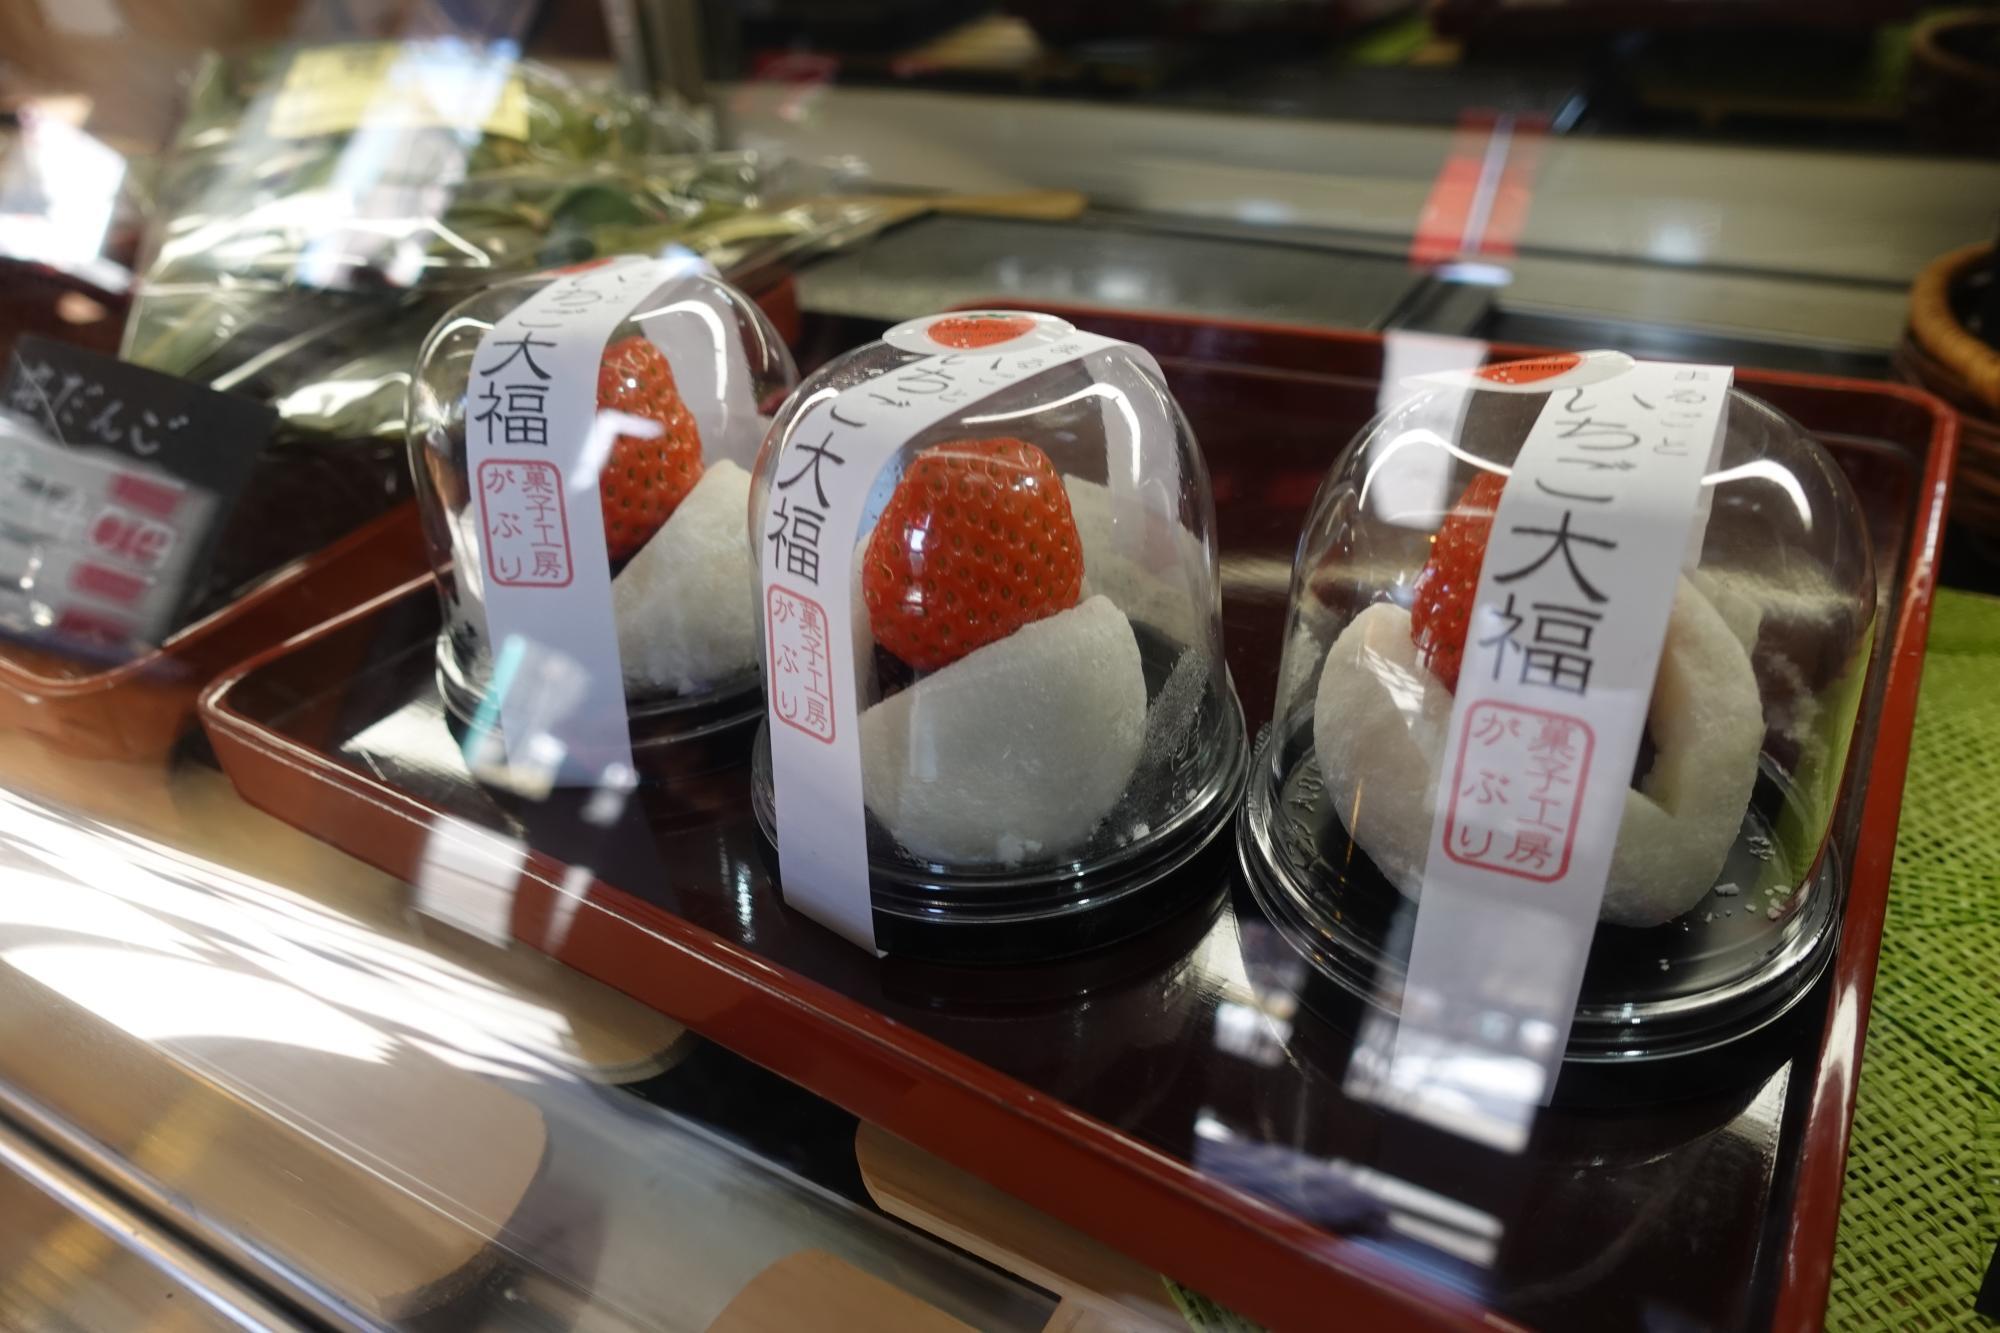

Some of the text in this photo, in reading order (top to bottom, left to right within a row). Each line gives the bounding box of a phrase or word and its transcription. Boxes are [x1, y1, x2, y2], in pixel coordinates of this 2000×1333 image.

[485, 466, 523, 581] がぶり
[520, 464, 564, 579] 菓子工房
[767, 353, 1003, 586] いちご大福
[1478, 387, 1655, 697] いちご大福
[773, 595, 801, 719] がぶり
[799, 601, 829, 732] 菓子工房
[1459, 712, 1521, 861] がぶり
[1504, 718, 1577, 870] 菓子工房
